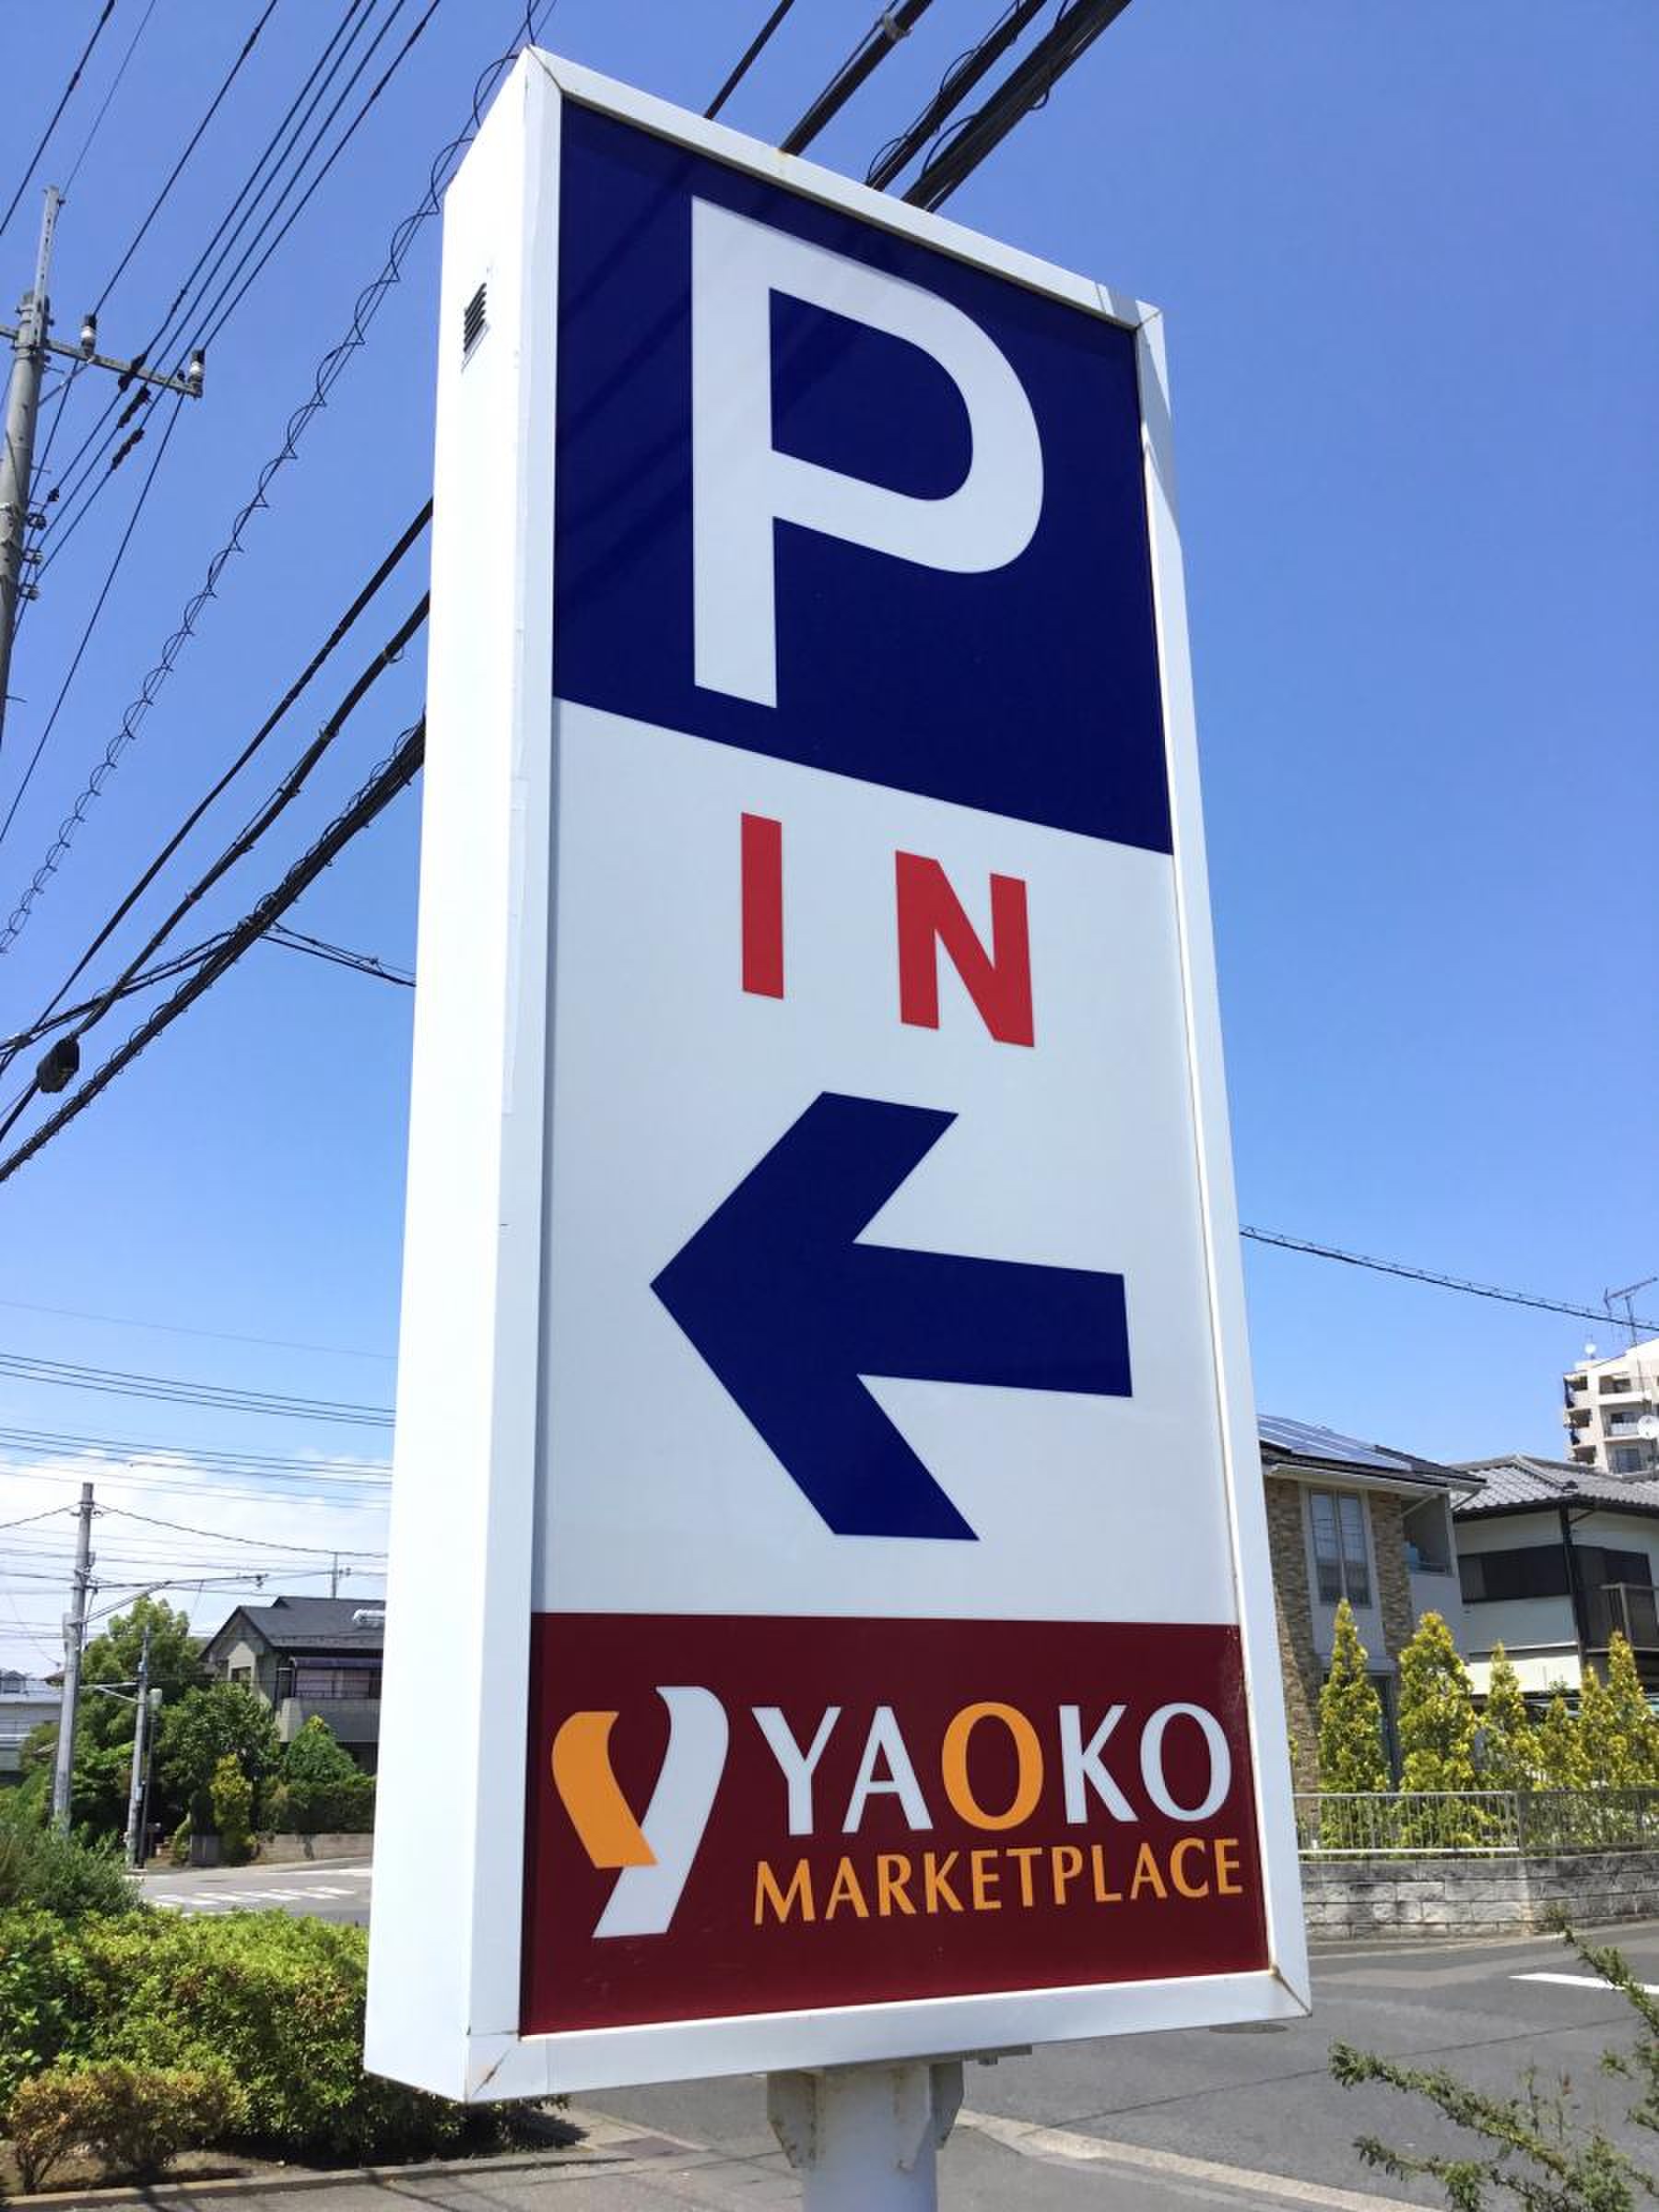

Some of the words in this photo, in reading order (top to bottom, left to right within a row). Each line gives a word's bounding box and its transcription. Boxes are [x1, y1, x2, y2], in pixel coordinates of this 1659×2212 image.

[691, 195, 1044, 709] P
[741, 813, 1035, 1047] IN
[751, 1701, 1232, 1836] YAOKO
[754, 1837, 1242, 1924] MARKETPLACE
